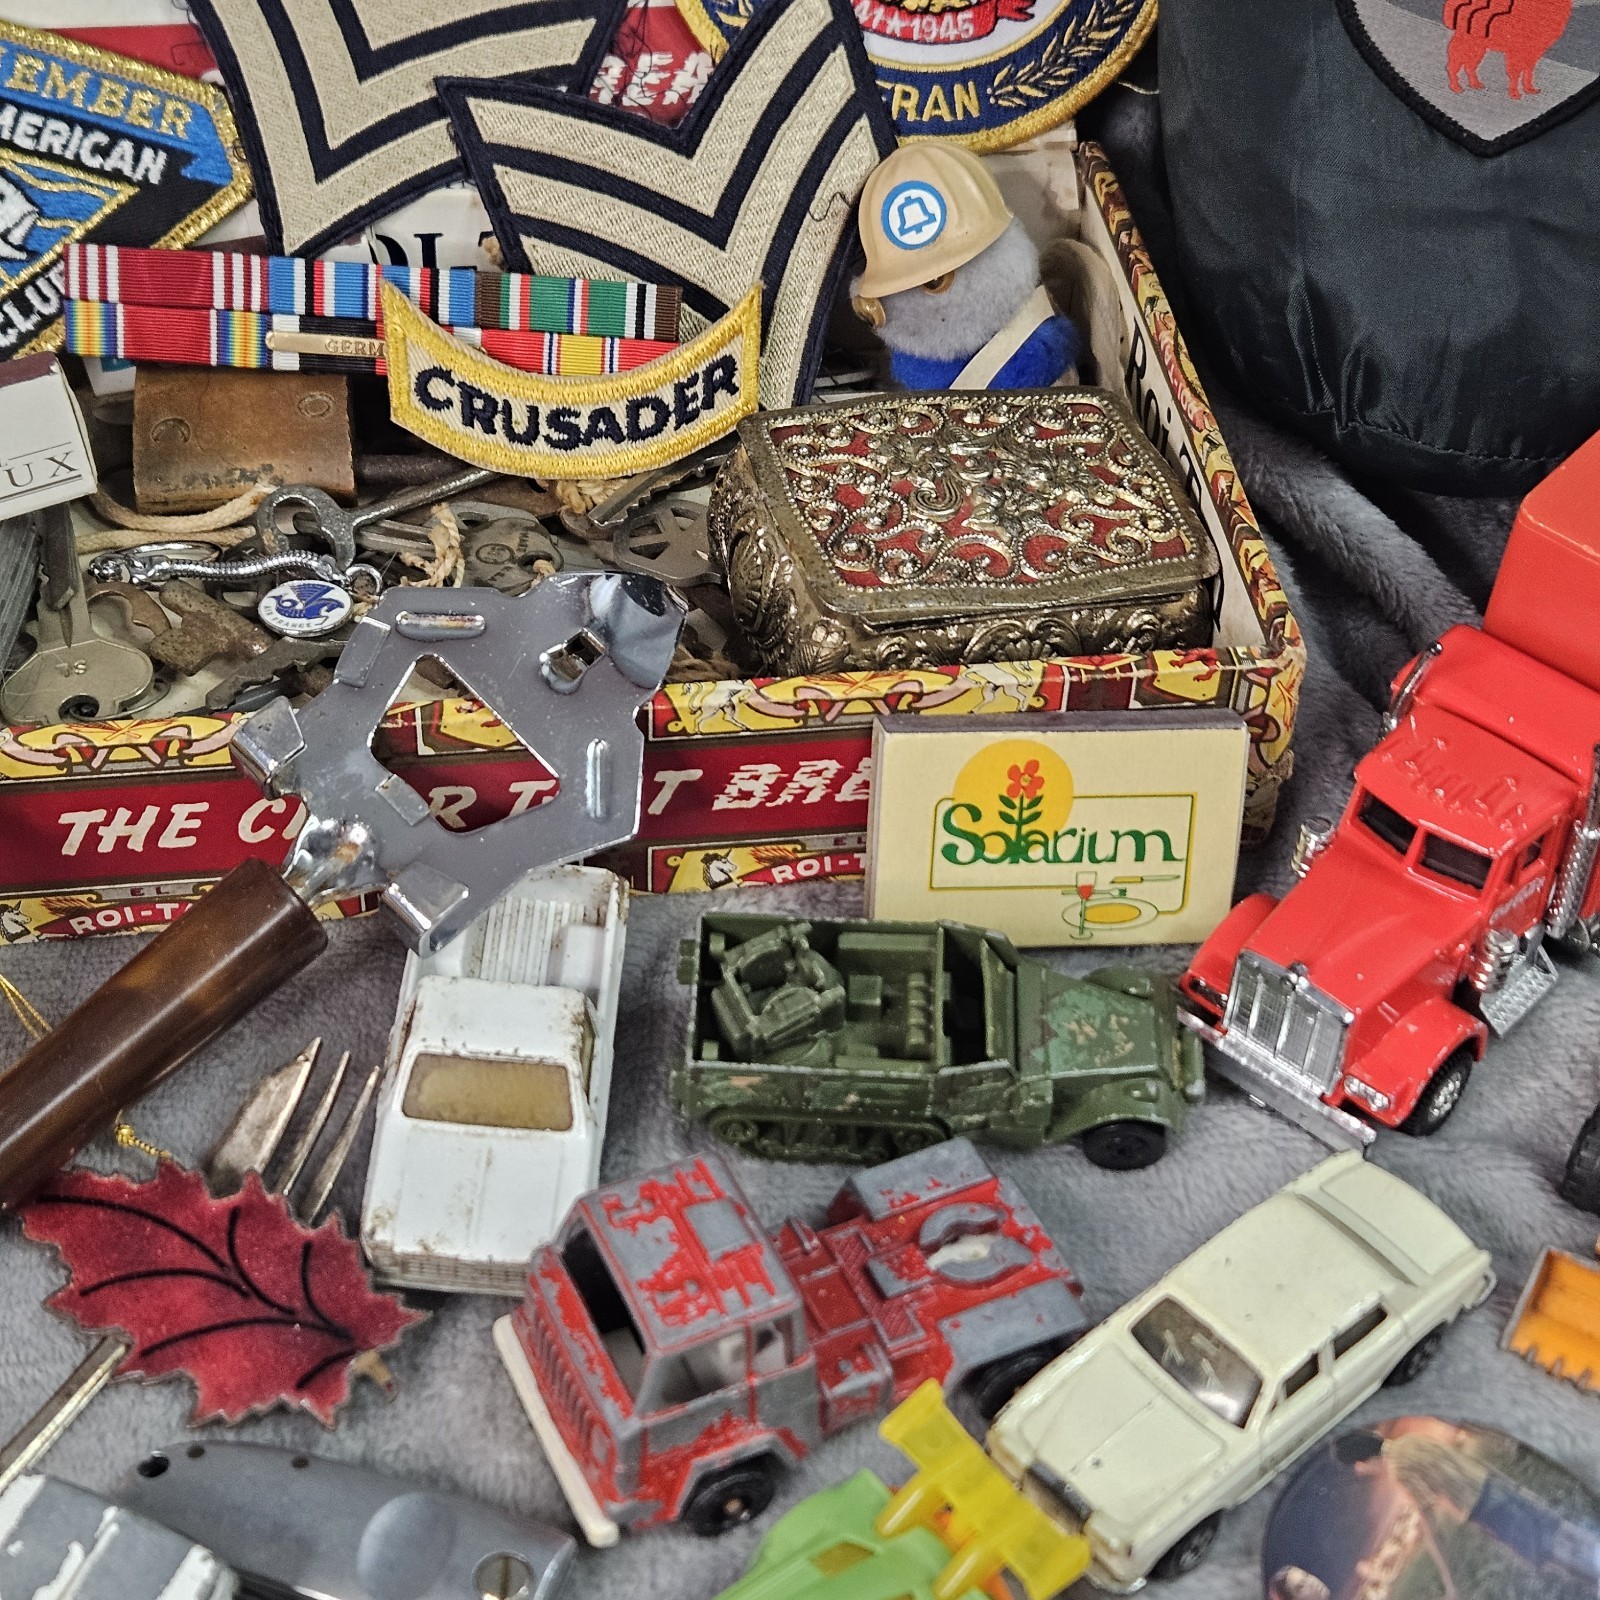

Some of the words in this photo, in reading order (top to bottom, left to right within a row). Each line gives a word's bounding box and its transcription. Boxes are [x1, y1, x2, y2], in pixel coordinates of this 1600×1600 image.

[911, 10, 974, 42] 1945
[0, 46, 192, 141] EMBER
[325, 339, 385, 357] GERM
[414, 355, 740, 451] CRUSADER
[272, 617, 313, 628] FRANCE
[58, 802, 210, 856] THE
[941, 803, 1185, 866] Solarium
[130, 886, 170, 897] EL
